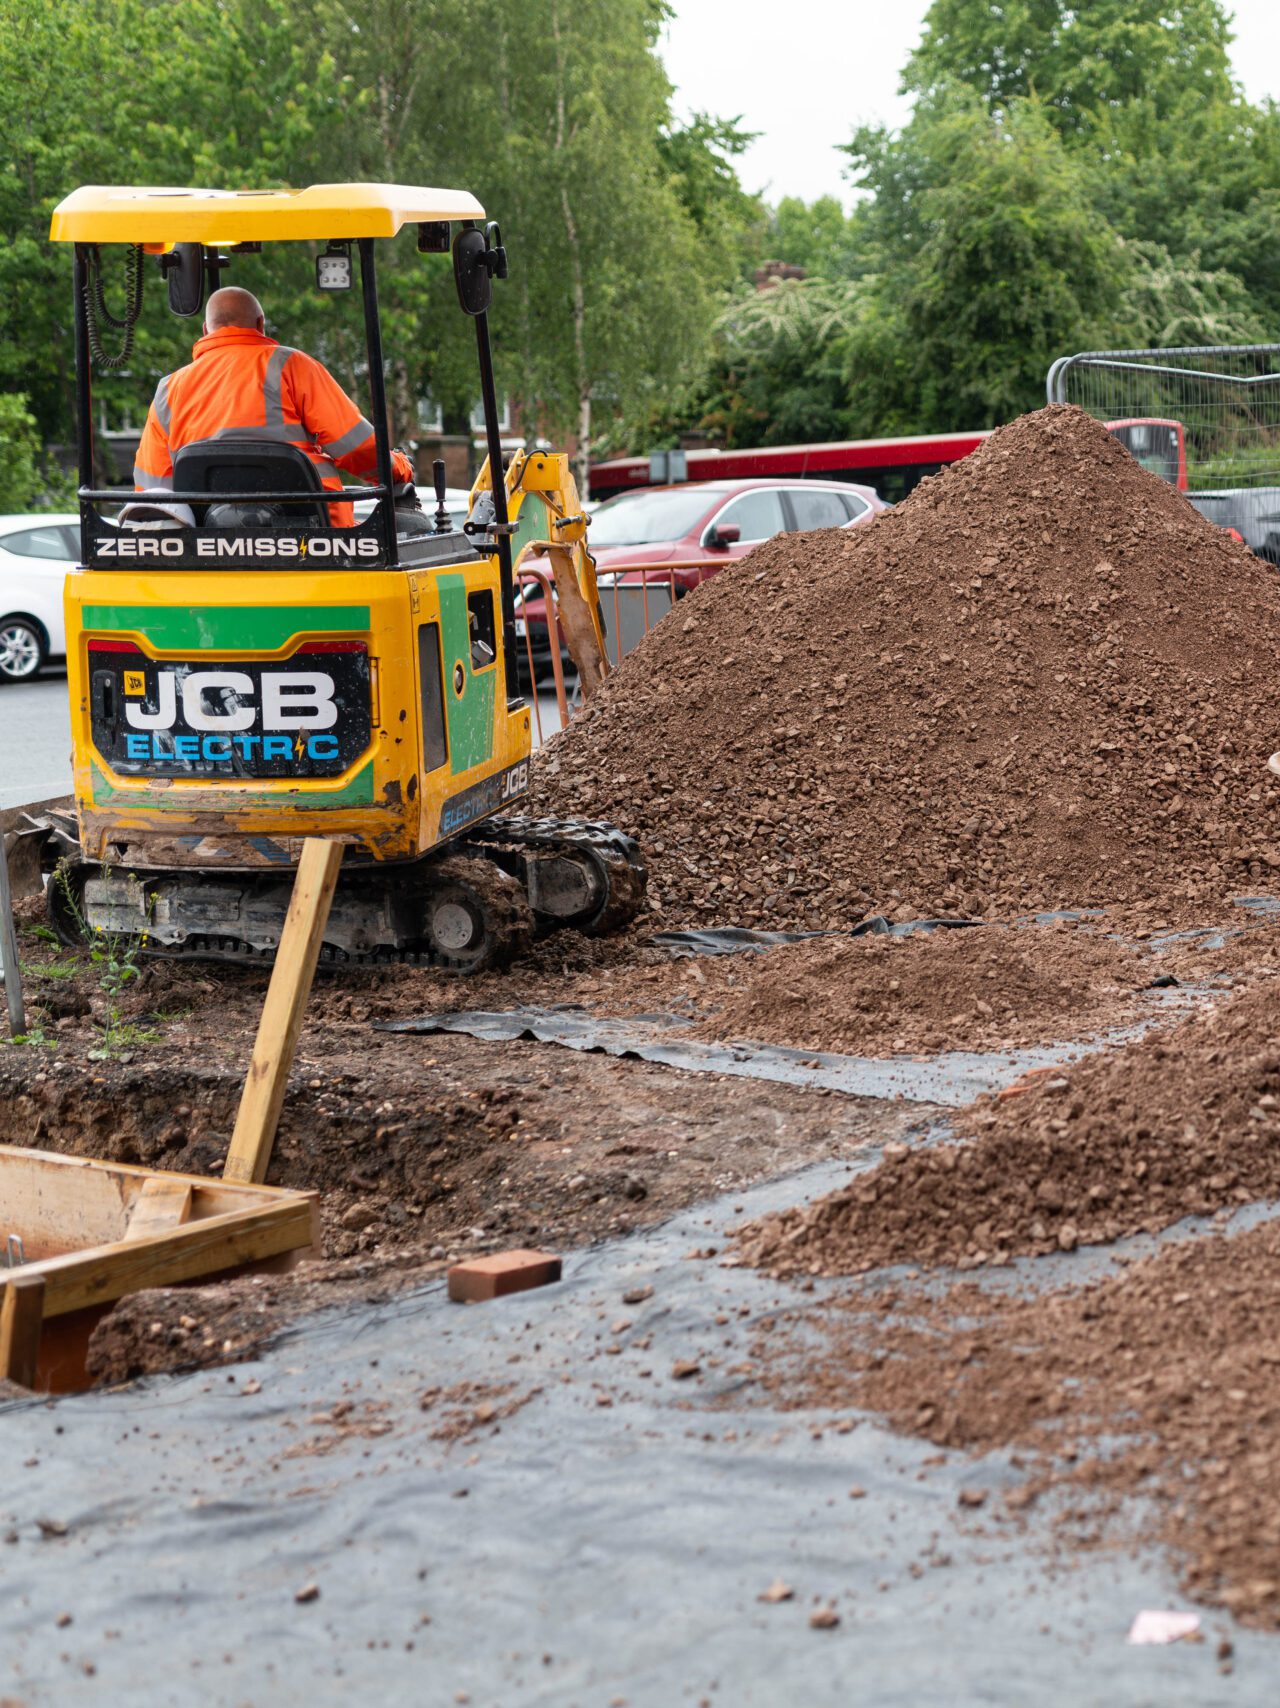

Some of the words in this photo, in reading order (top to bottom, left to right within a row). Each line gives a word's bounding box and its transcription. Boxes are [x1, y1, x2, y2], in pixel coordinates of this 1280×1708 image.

[96, 538, 184, 556] ZERO
[125, 671, 338, 731] JCB
[502, 763, 528, 799] JCB
